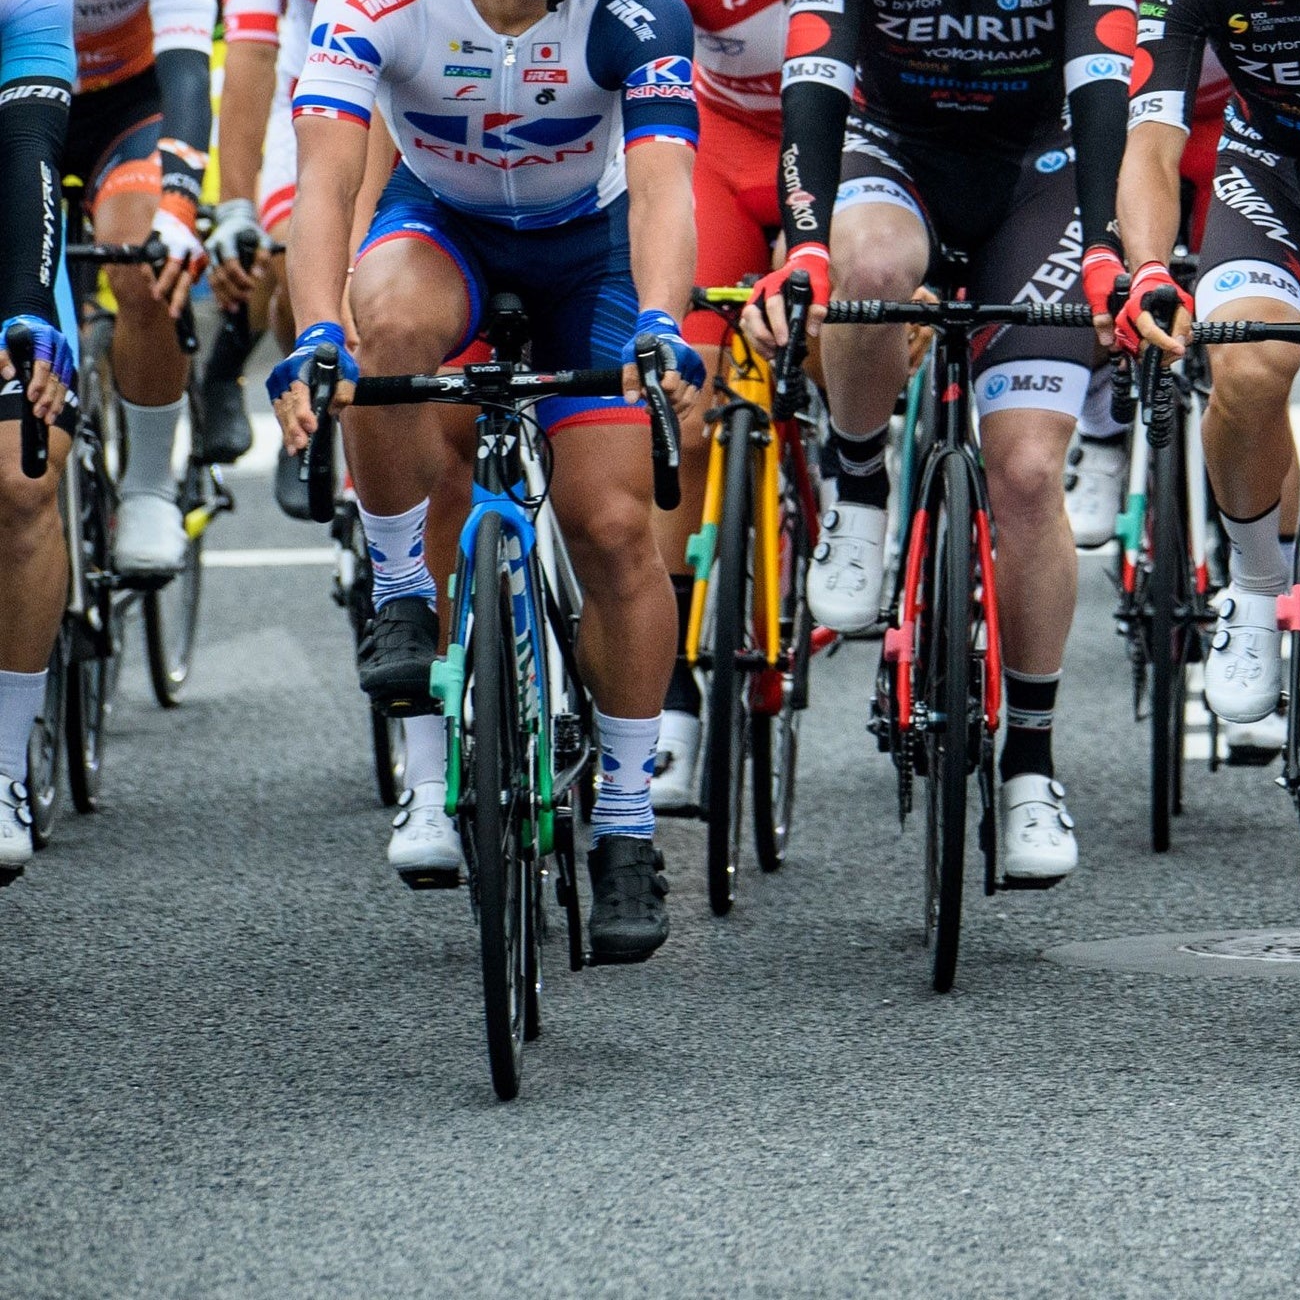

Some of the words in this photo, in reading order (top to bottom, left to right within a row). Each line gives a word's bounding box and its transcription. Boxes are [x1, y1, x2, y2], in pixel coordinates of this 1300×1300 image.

[875, 9, 1056, 42] ZENRIN
[1250, 12, 1268, 20] UCI
[309, 53, 375, 75] KINAN
[923, 46, 1043, 61] YOKOHAMA
[787, 63, 839, 81] MJS
[414, 137, 595, 172] KINAN
[1212, 166, 1299, 252] ZENRIN
[1248, 270, 1300, 299] MJS
[1009, 374, 1064, 393] MJS
